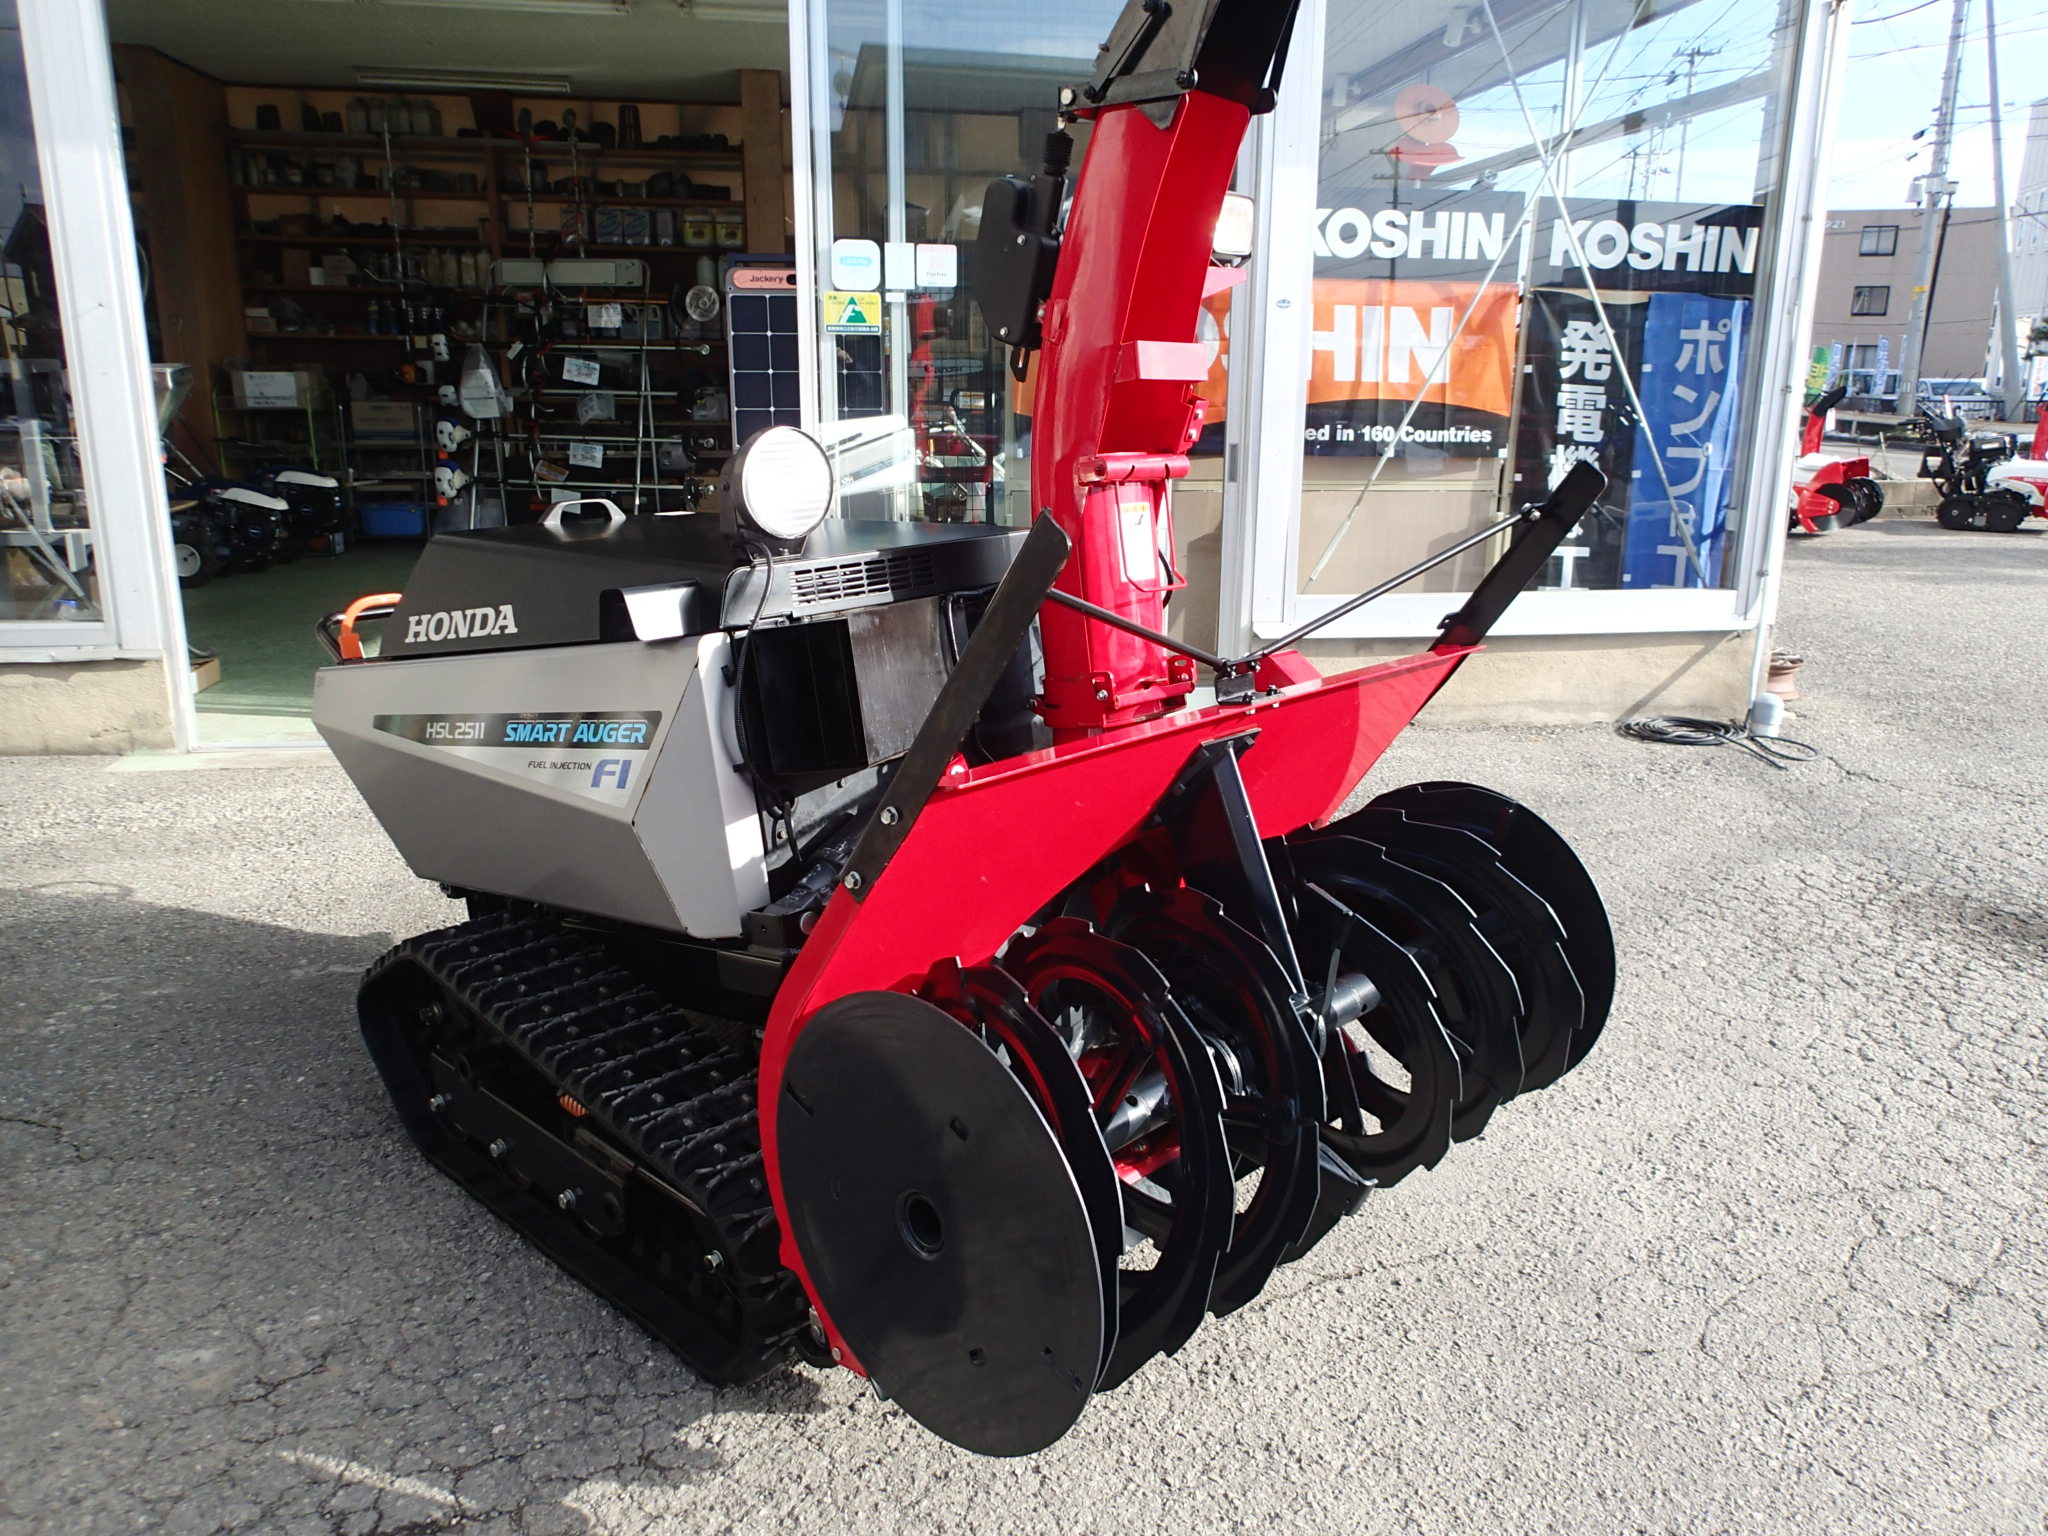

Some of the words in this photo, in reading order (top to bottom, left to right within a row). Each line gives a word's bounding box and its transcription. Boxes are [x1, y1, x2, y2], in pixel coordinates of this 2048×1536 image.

[1549, 219, 1760, 274] KOSHIN
[750, 275, 784, 285] Jackery
[1304, 425, 1331, 441] ed
[1336, 425, 1355, 441] in
[1362, 425, 1396, 441] 160
[1399, 426, 1492, 443] Countries
[404, 604, 518, 643] HONDA
[426, 722, 485, 740] HSL2511
[503, 720, 571, 742] SMART
[573, 720, 647, 744] AUGER
[528, 760, 548, 769] FUEL
[550, 760, 592, 771] INJECTION
[591, 758, 632, 790] FI
